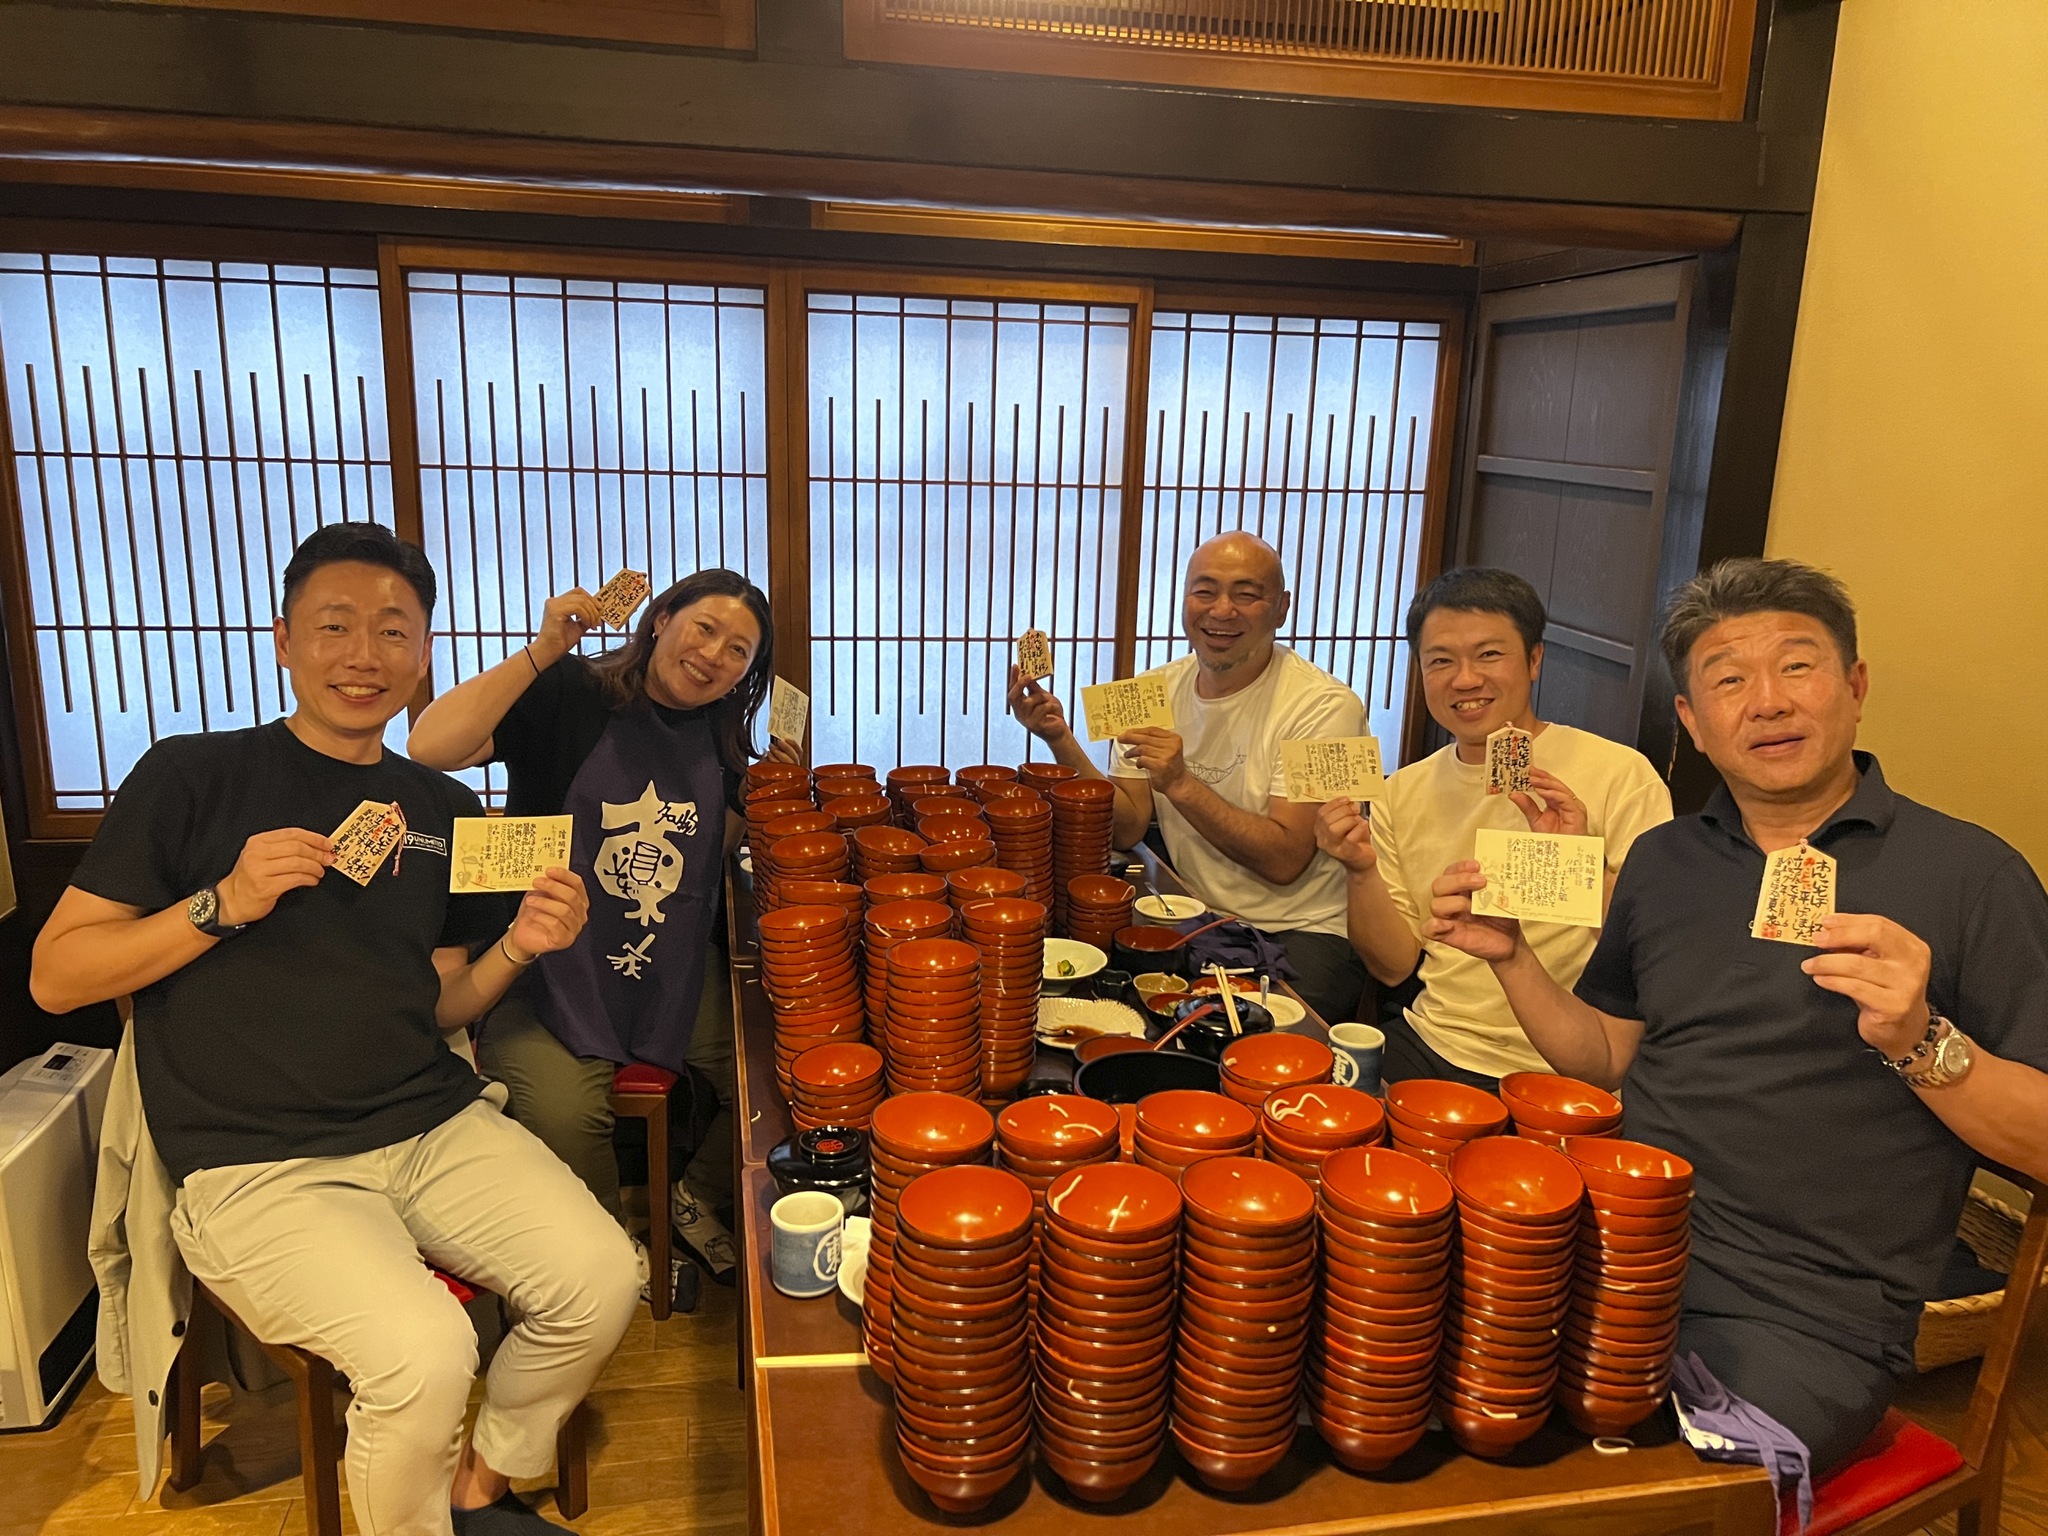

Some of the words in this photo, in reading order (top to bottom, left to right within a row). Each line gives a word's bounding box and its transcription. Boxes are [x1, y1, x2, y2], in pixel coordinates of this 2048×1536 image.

[371, 822, 402, 856] わんこそば
[1810, 860, 1831, 909] わんこそば
